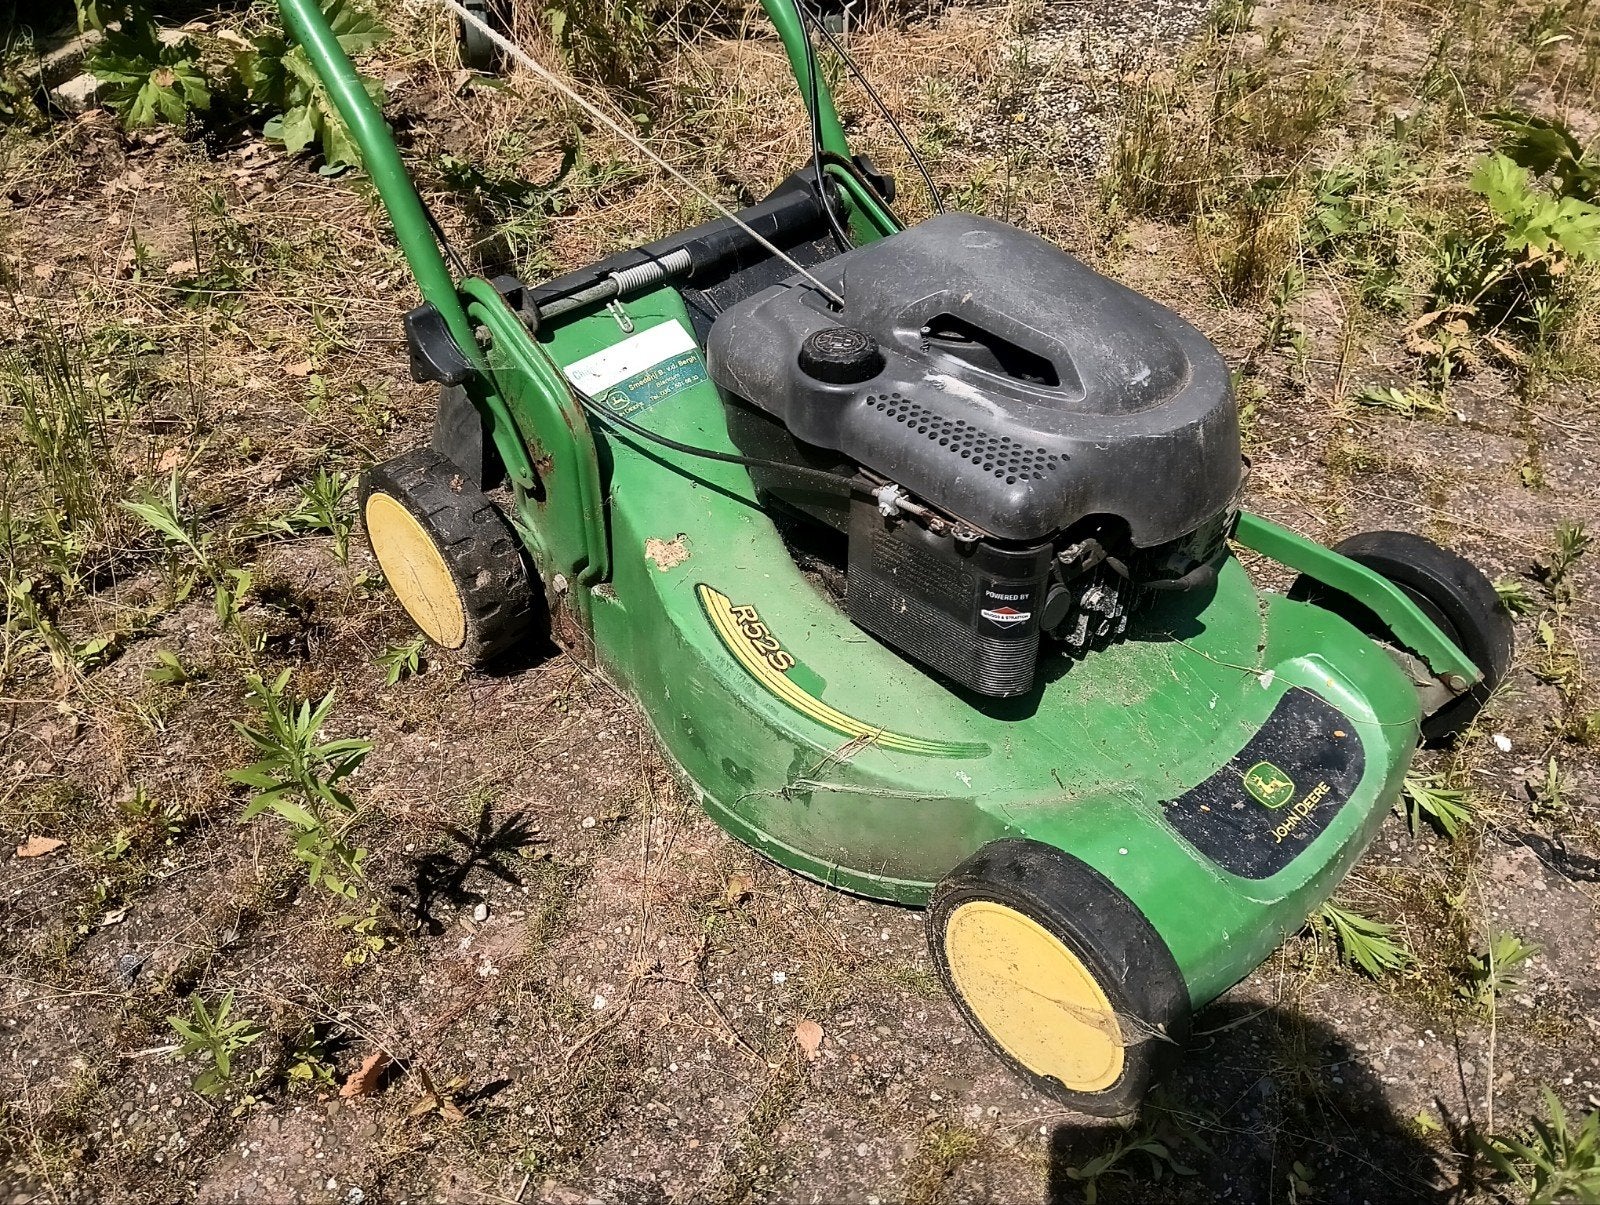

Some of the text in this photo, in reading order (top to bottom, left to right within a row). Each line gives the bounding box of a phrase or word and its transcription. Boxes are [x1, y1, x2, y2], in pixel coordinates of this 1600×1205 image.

[678, 356, 697, 366] Bergh
[985, 590, 1018, 600] POWERED
[729, 604, 796, 672] R52S
[1271, 781, 1331, 844] JOHN DEERE
